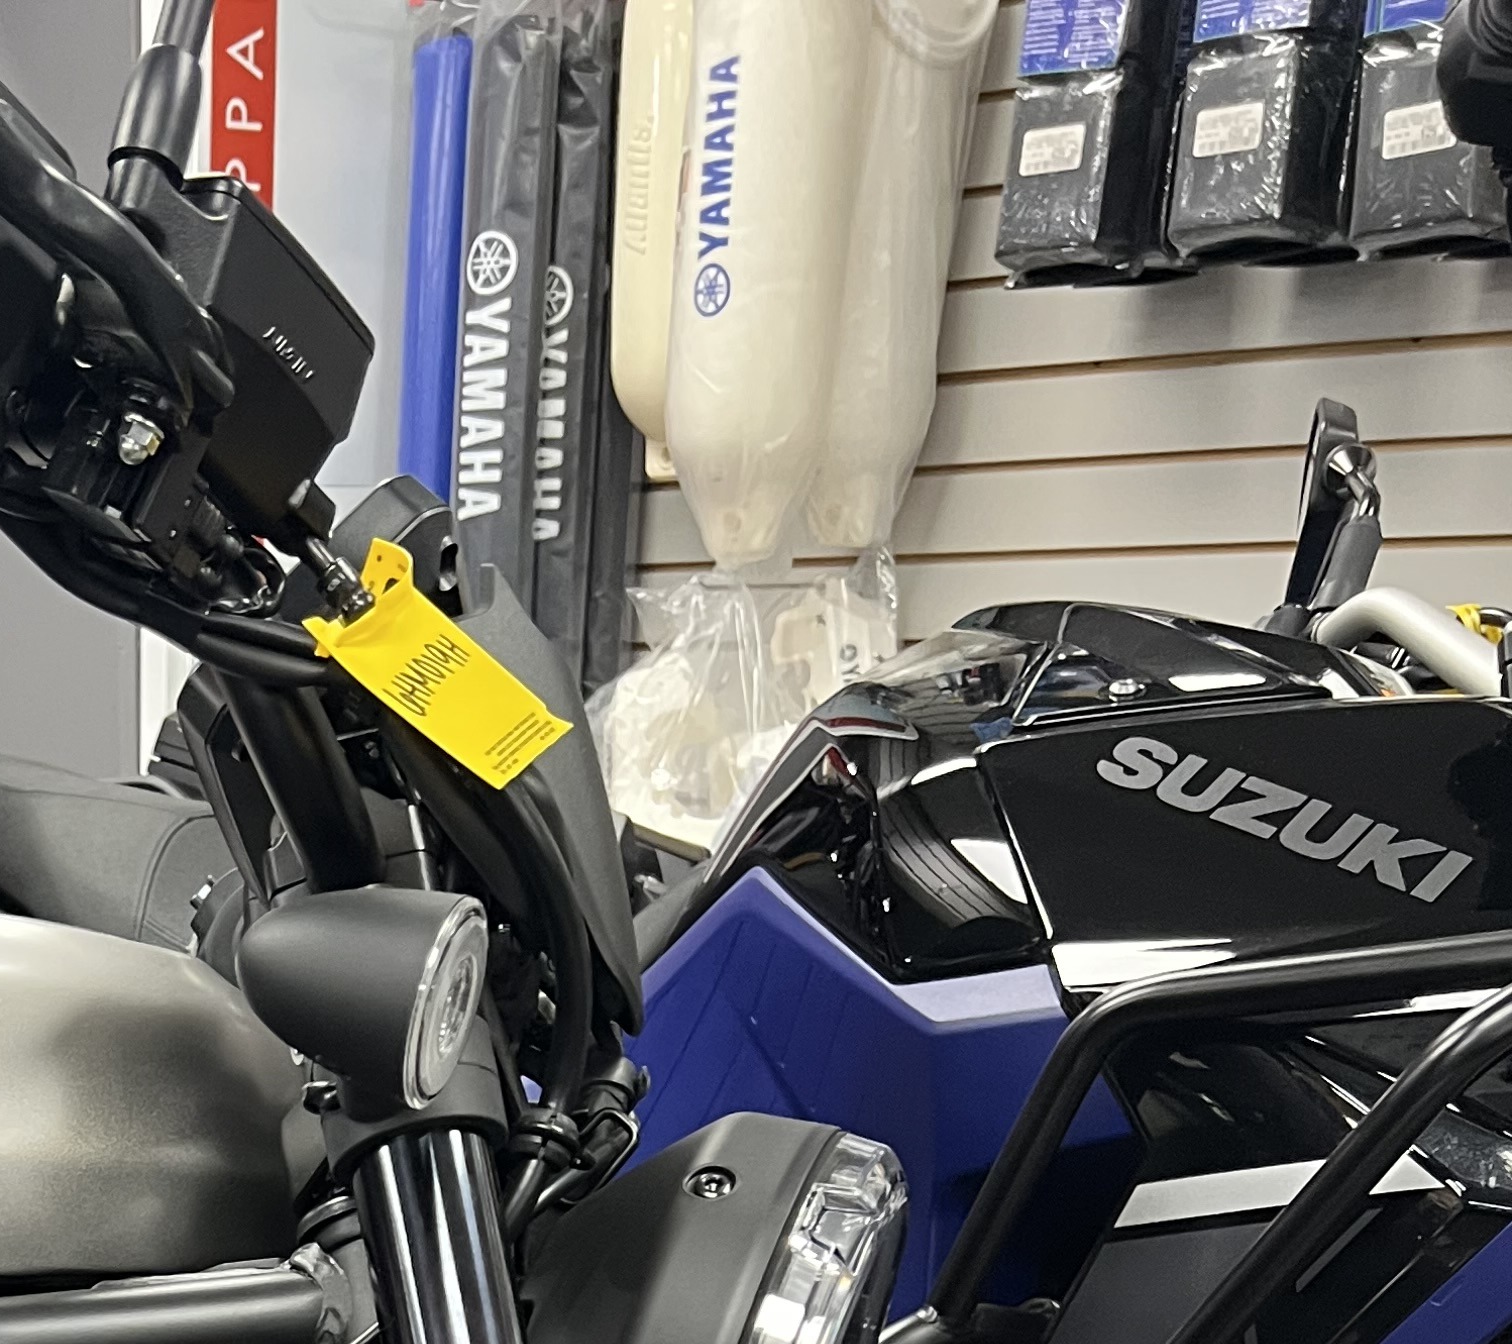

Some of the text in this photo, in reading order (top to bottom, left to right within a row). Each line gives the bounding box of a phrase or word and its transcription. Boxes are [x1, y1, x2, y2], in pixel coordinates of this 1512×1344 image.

[698, 55, 740, 260] YAMAHA
[457, 297, 512, 522] YAMAHA
[532, 327, 569, 541] YAMAHA
[1095, 736, 1474, 903] SUZUKI
